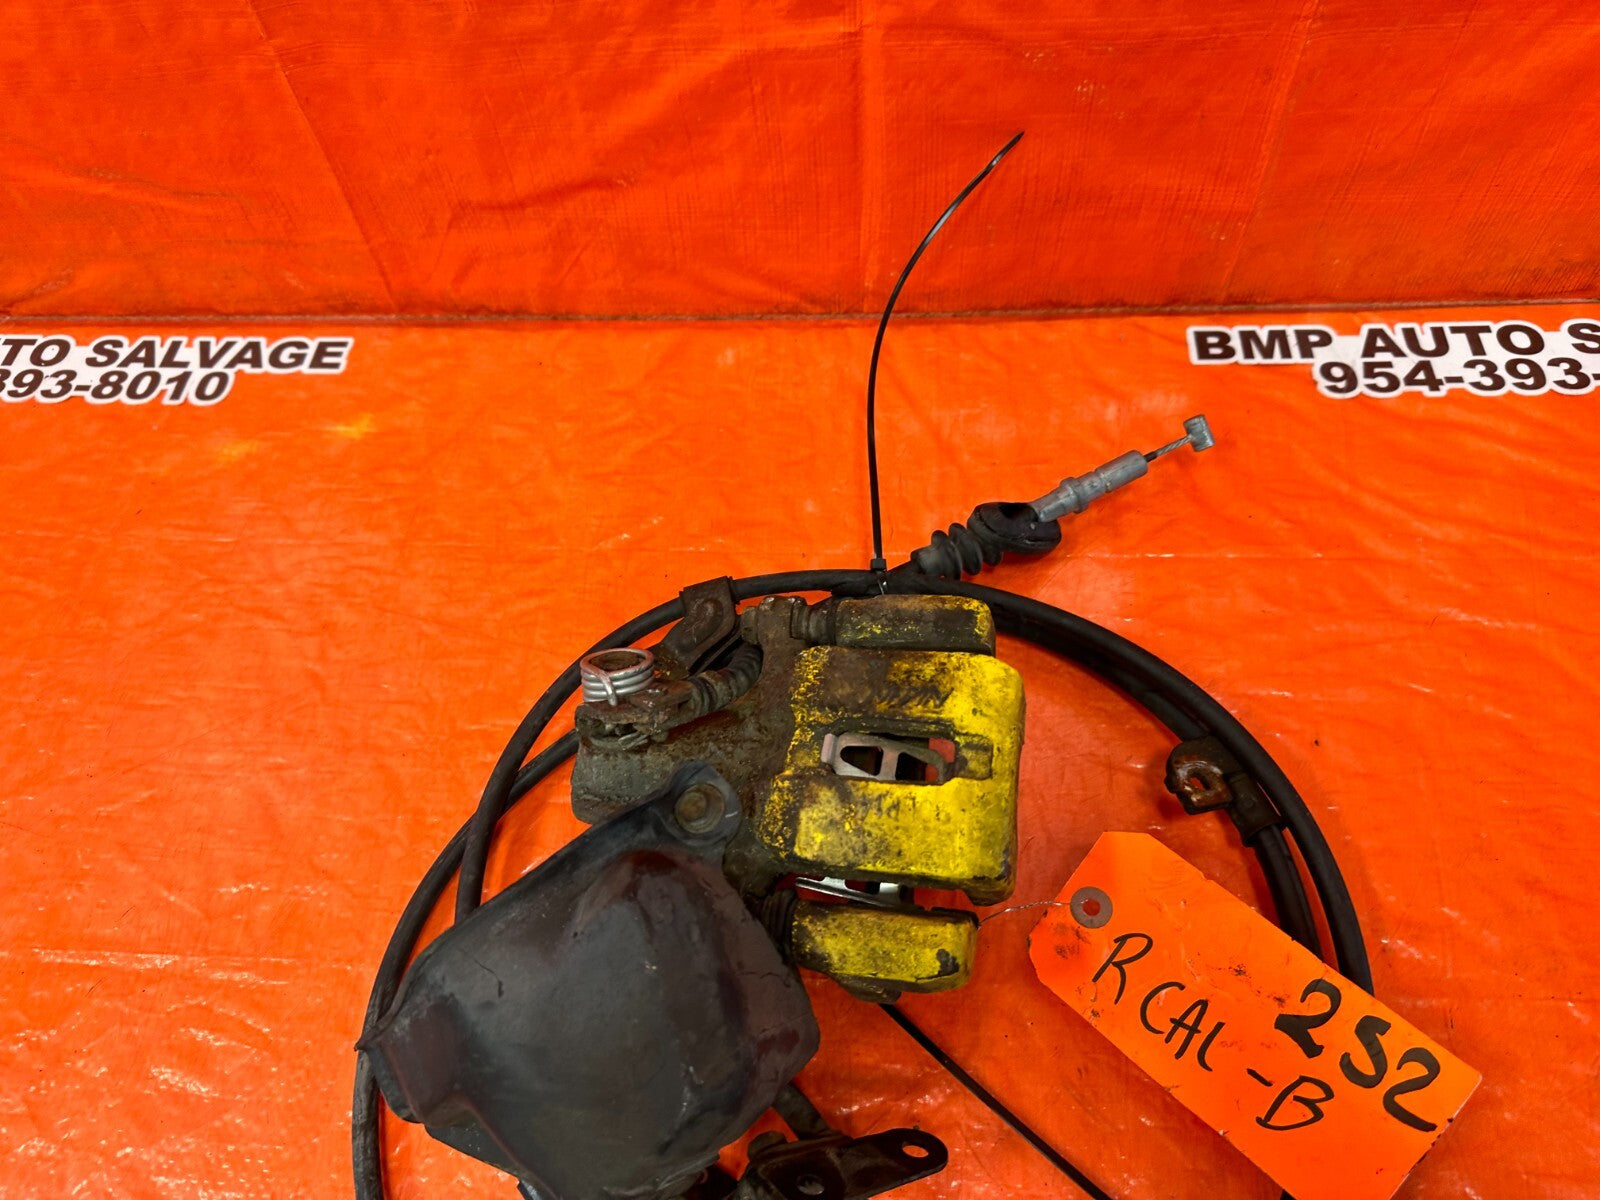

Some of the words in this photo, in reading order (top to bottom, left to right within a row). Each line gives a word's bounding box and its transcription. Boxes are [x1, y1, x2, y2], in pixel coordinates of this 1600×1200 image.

[0, 338, 71, 367] TO
[85, 339, 350, 370] SALVAGE
[1192, 328, 1332, 360] BMP
[1360, 324, 1545, 358] AUTO
[1092, 932, 1153, 1005] R
[1139, 981, 1226, 1072] CAL
[1273, 978, 1442, 1133] 252
